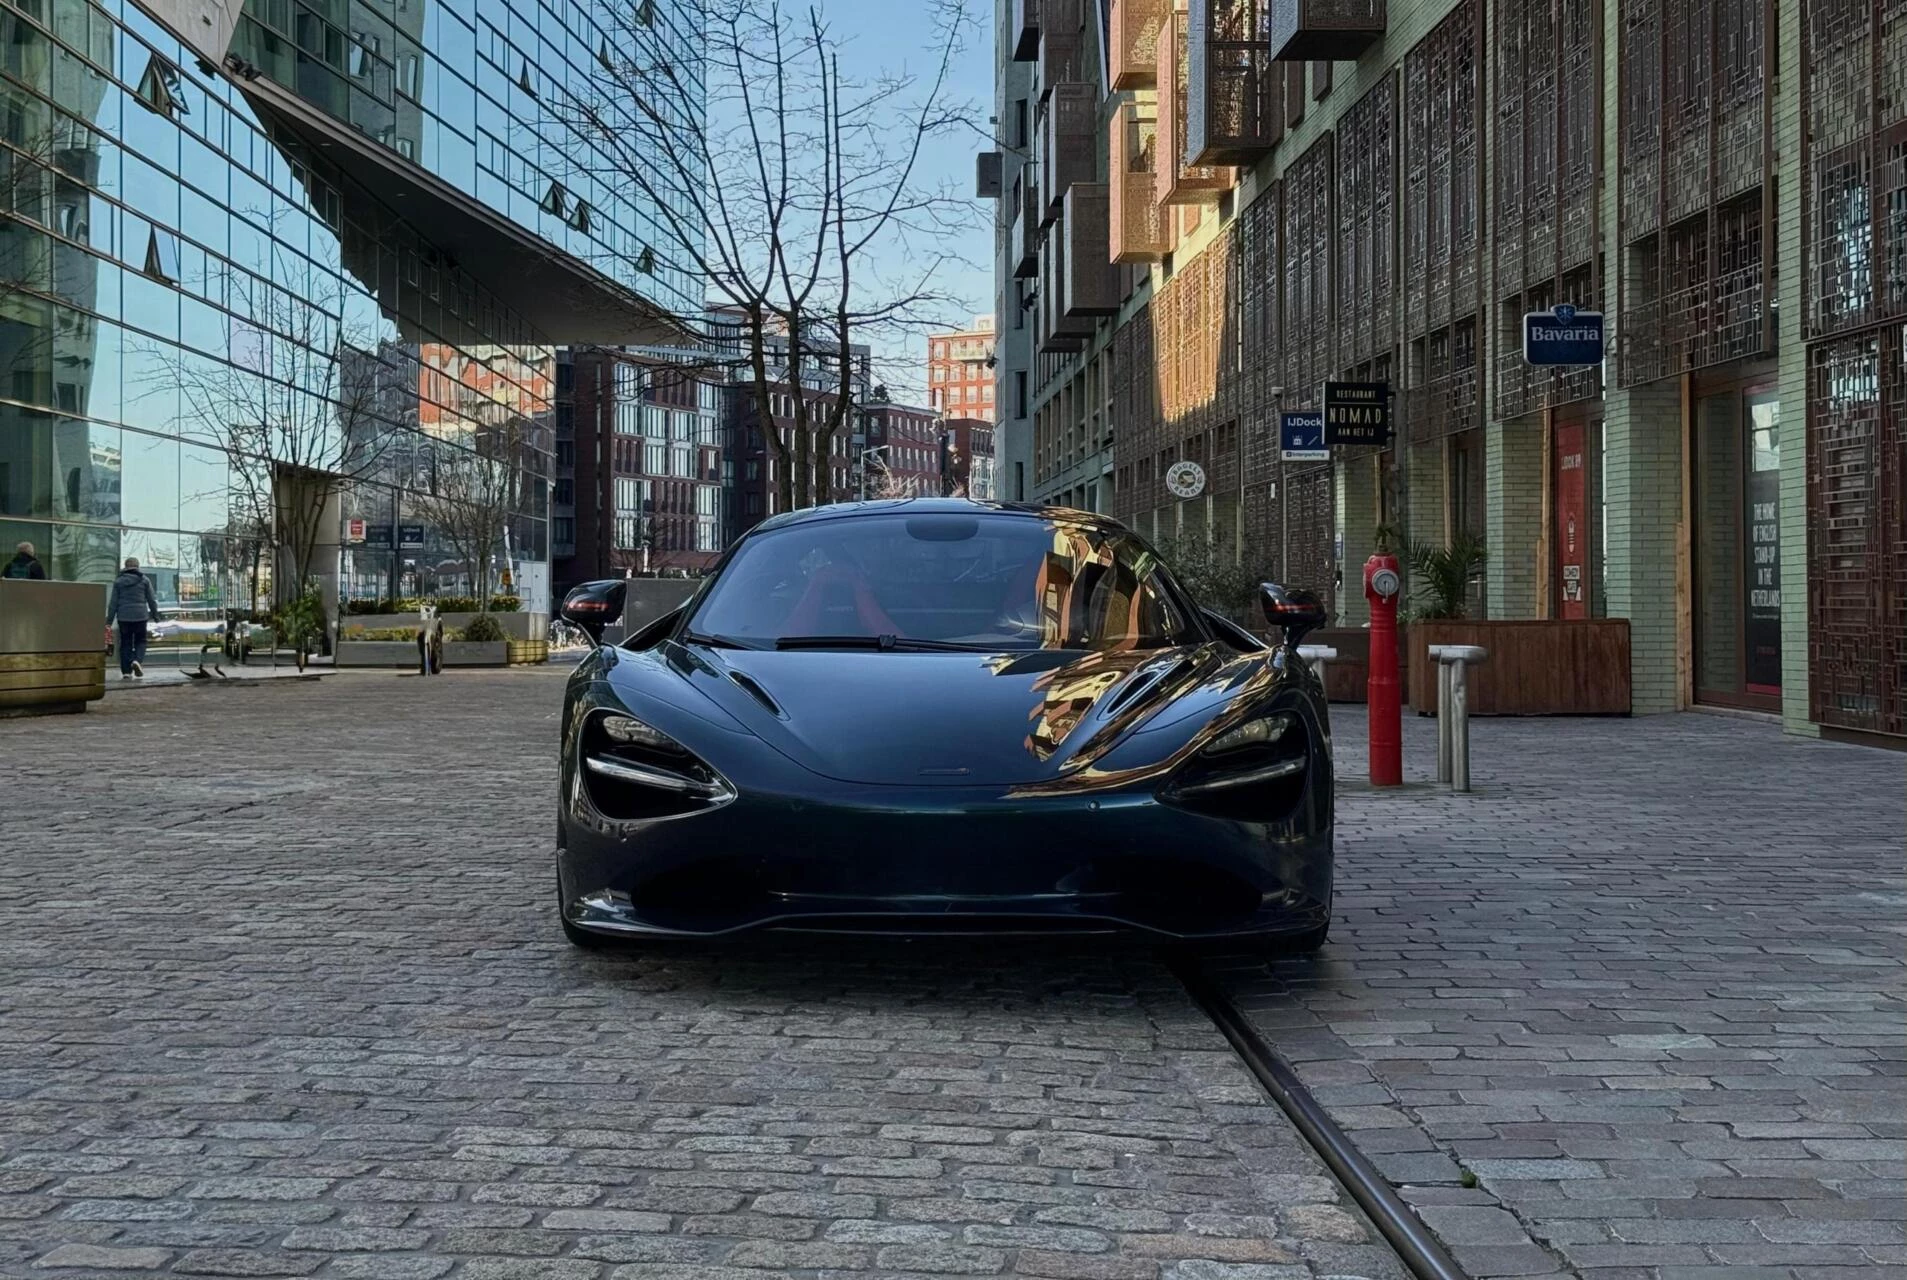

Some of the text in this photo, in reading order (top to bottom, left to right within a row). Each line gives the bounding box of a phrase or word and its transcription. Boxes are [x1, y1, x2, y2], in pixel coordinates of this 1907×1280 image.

[1531, 326, 1600, 341] Bavaria
[1336, 390, 1376, 399] RESTAURANT
[1287, 418, 1322, 427] IJDock
[1329, 408, 1381, 424] NOMAD
[1753, 502, 1775, 520] THE HOME
[1754, 546, 1775, 564] STAND-UP
[1758, 568, 1772, 585] IN THE
[1751, 589, 1780, 607] NETHERLANDS
